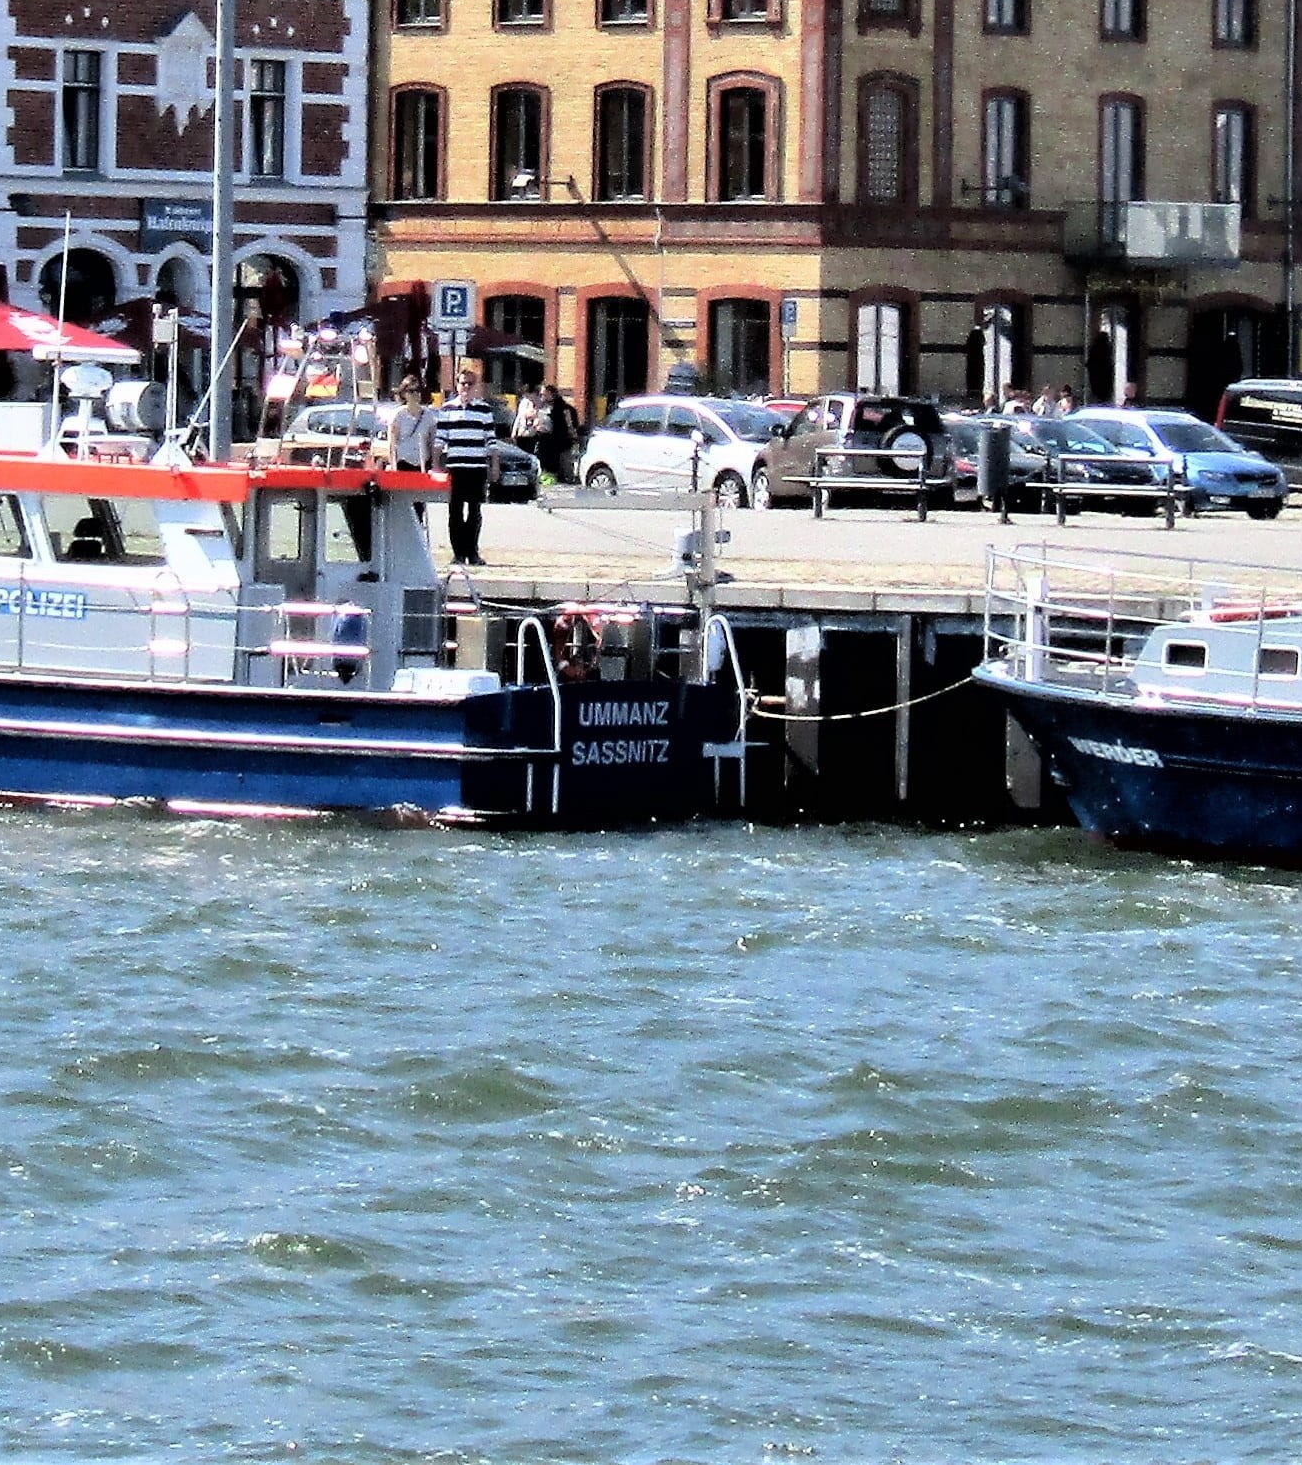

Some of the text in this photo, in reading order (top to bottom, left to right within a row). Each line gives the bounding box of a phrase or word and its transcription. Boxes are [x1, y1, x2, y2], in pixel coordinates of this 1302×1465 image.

[446, 289, 462, 314] P
[578, 701, 670, 727] UMMANZ
[571, 739, 670, 766] SASSNITZ
[1067, 736, 1164, 768] WERDER
